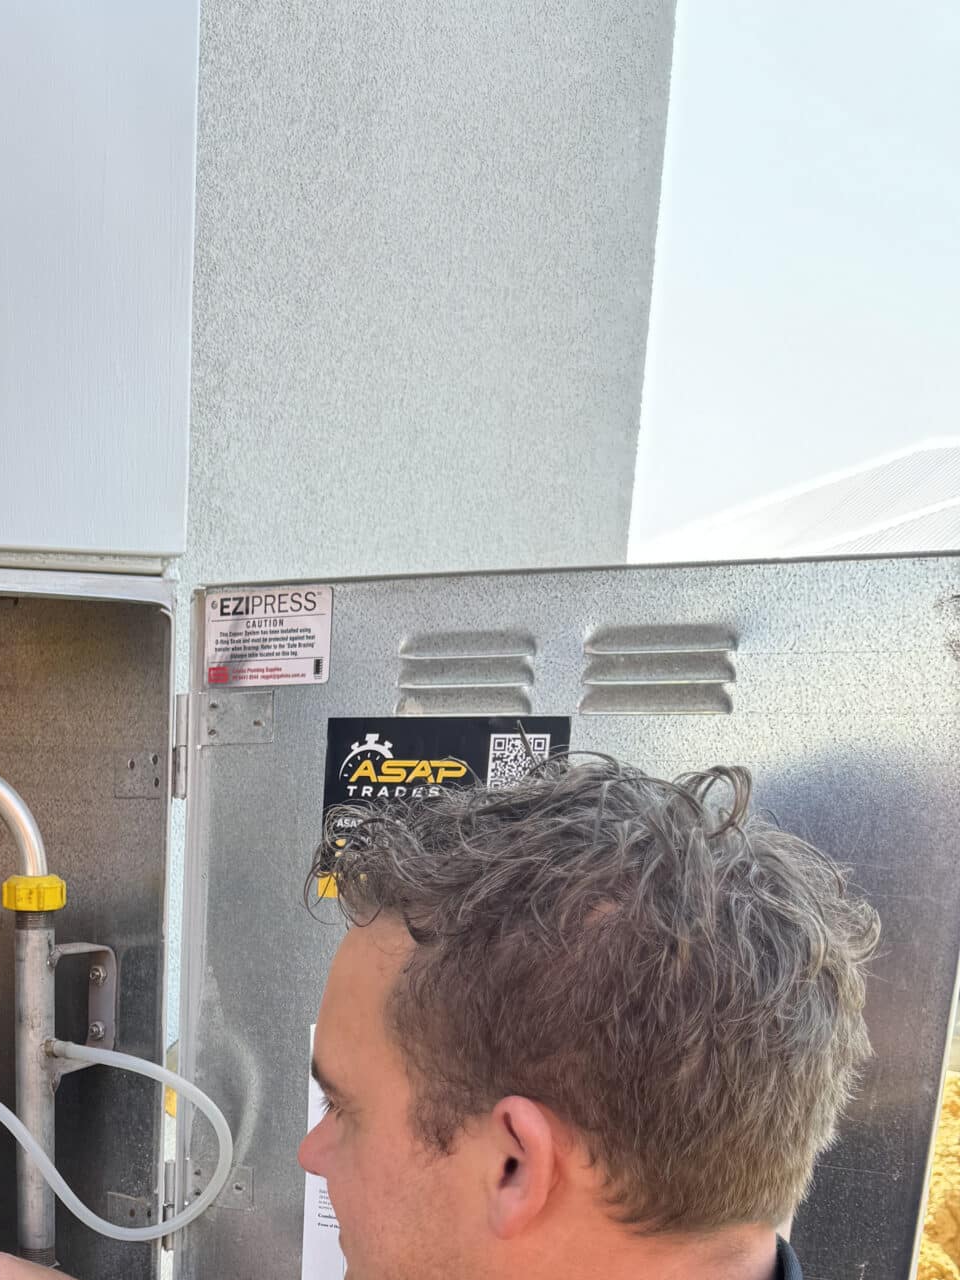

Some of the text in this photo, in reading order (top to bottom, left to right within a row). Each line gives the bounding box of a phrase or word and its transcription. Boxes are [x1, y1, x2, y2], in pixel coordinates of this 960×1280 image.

[220, 591, 317, 616] EZIPRESS
[246, 619, 284, 629] CAUTION
[349, 759, 467, 784] ASAP
[347, 786, 440, 798] TRADES
